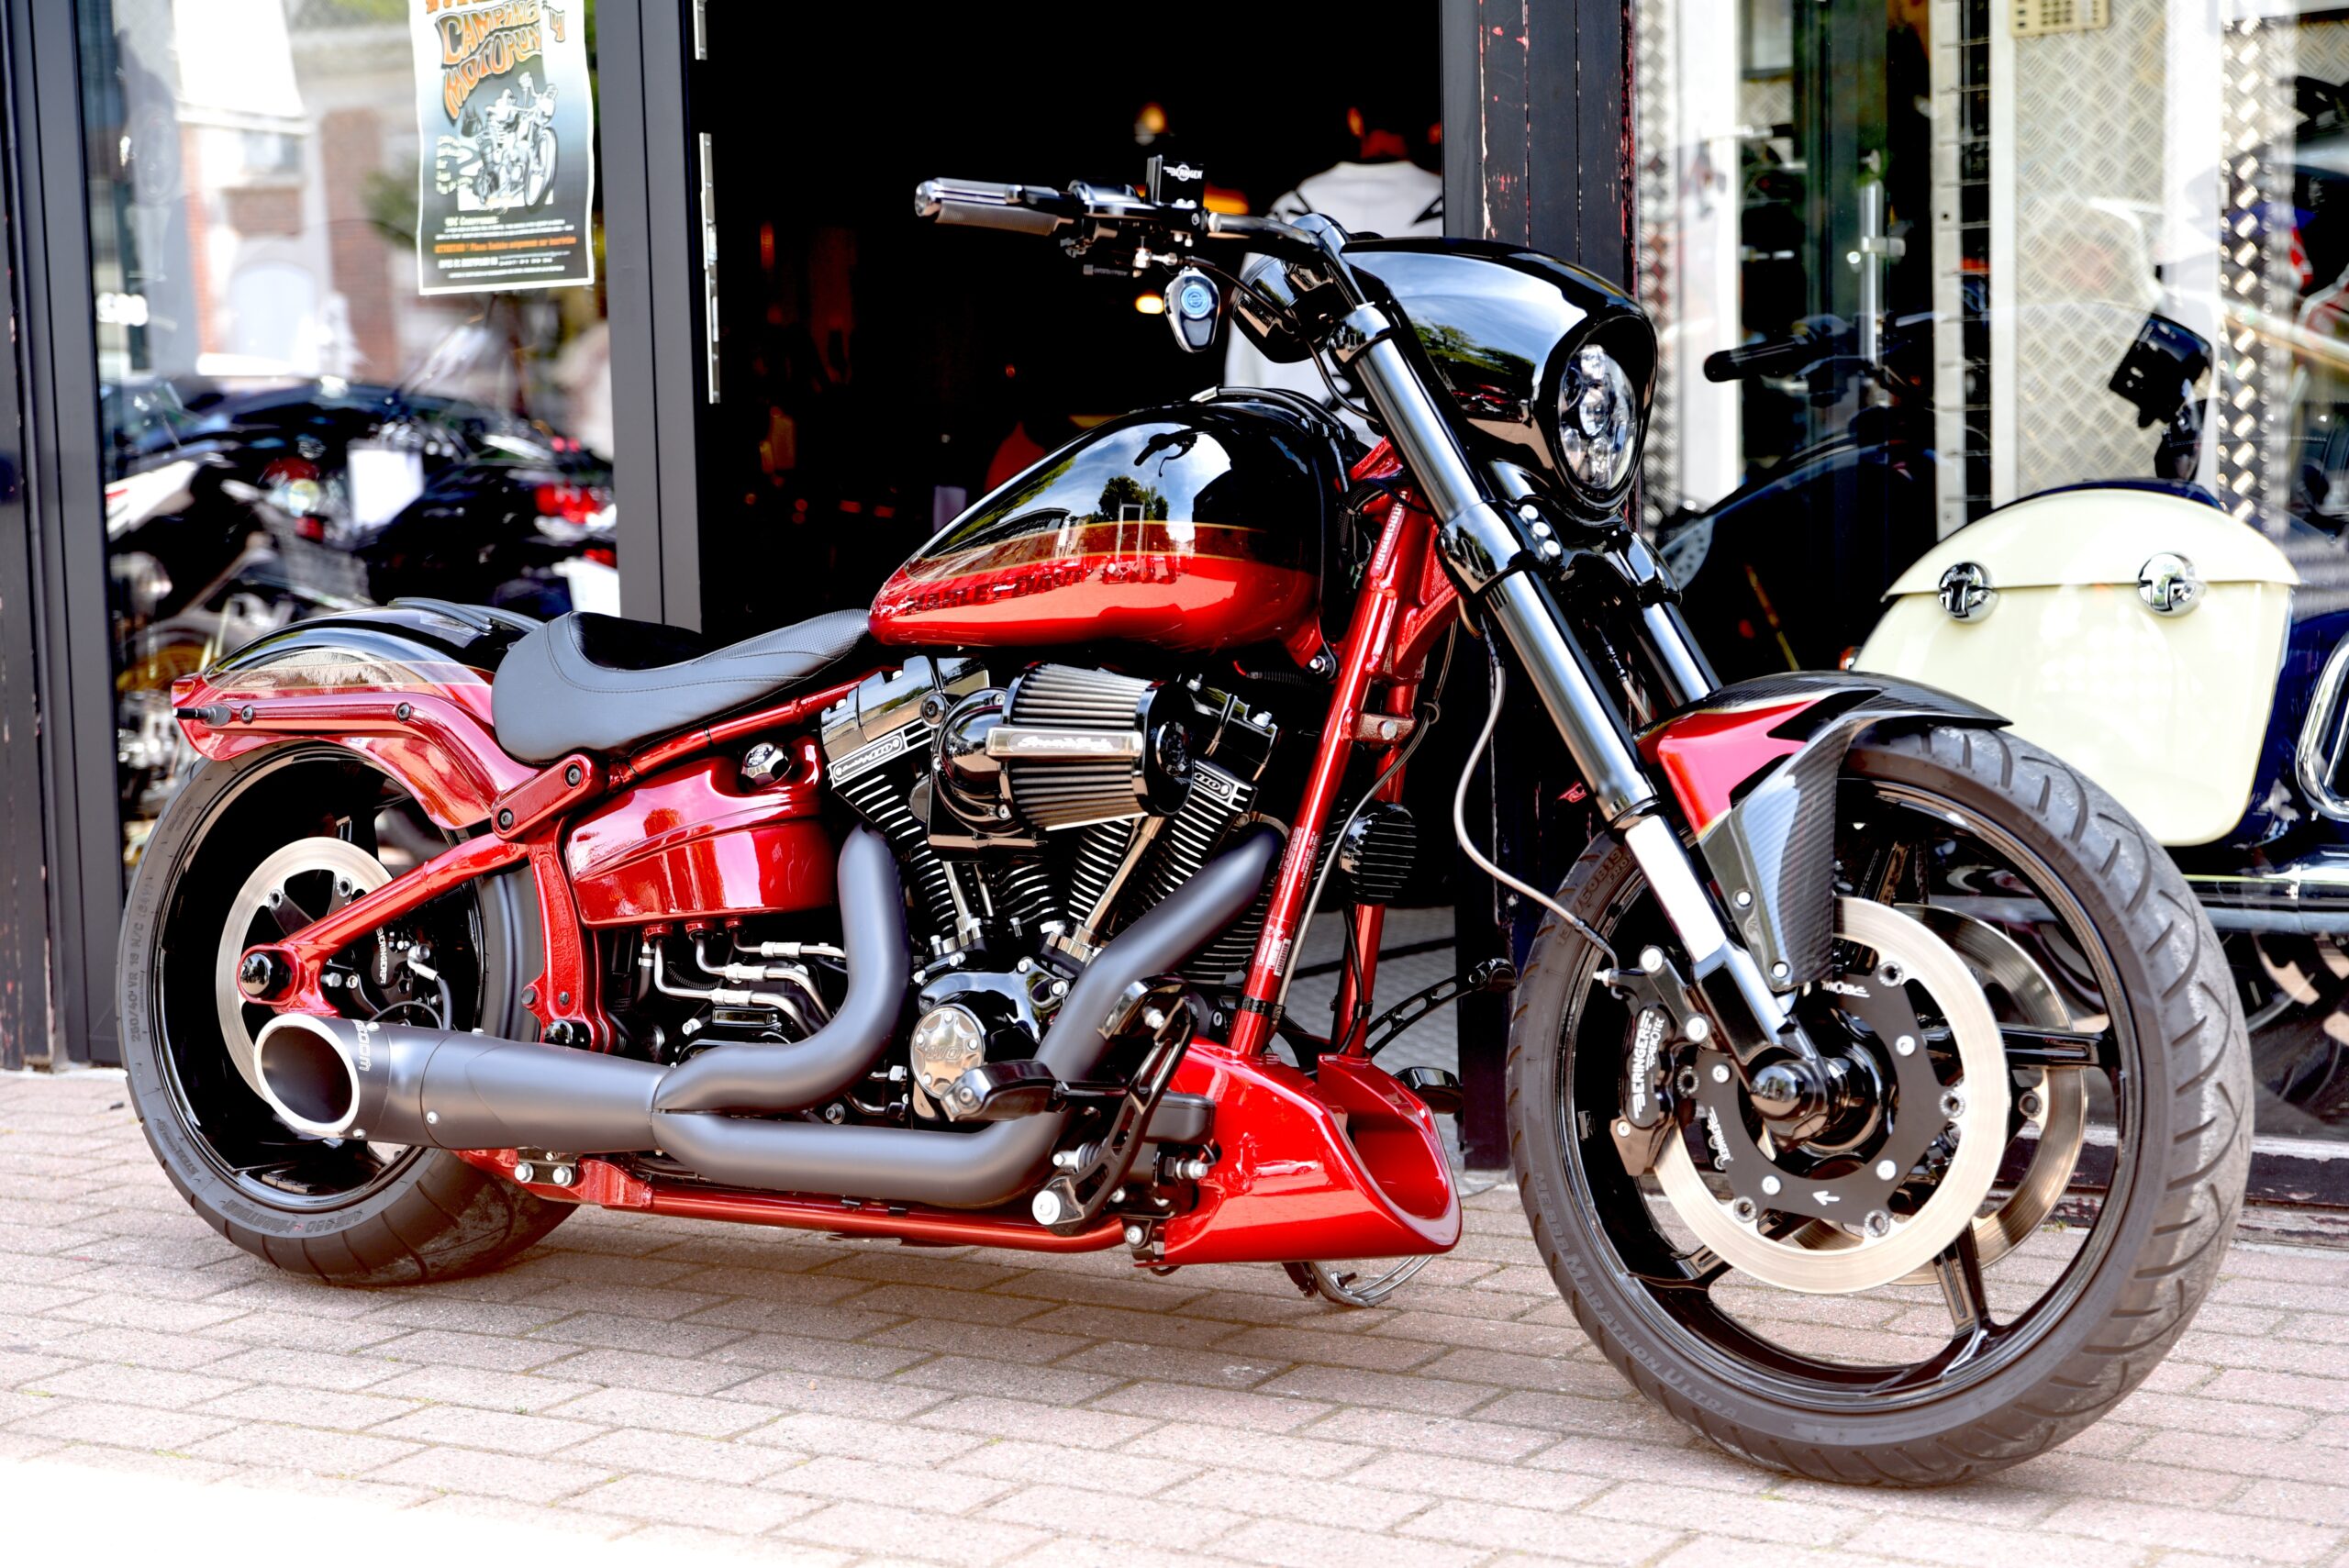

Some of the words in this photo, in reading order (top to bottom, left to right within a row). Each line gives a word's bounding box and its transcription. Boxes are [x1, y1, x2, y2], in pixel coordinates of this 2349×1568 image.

[436, 0, 540, 64] CAMPING
[444, 23, 542, 121] MOTORUN
[1632, 1010, 1653, 1118] BERINGER
[1646, 1017, 1664, 1071] AEROTEC
[1708, 1106, 1733, 1162] BERINGER
[1565, 1253, 1662, 1372] MARATHON
[1664, 1368, 1739, 1419] ULTRA
